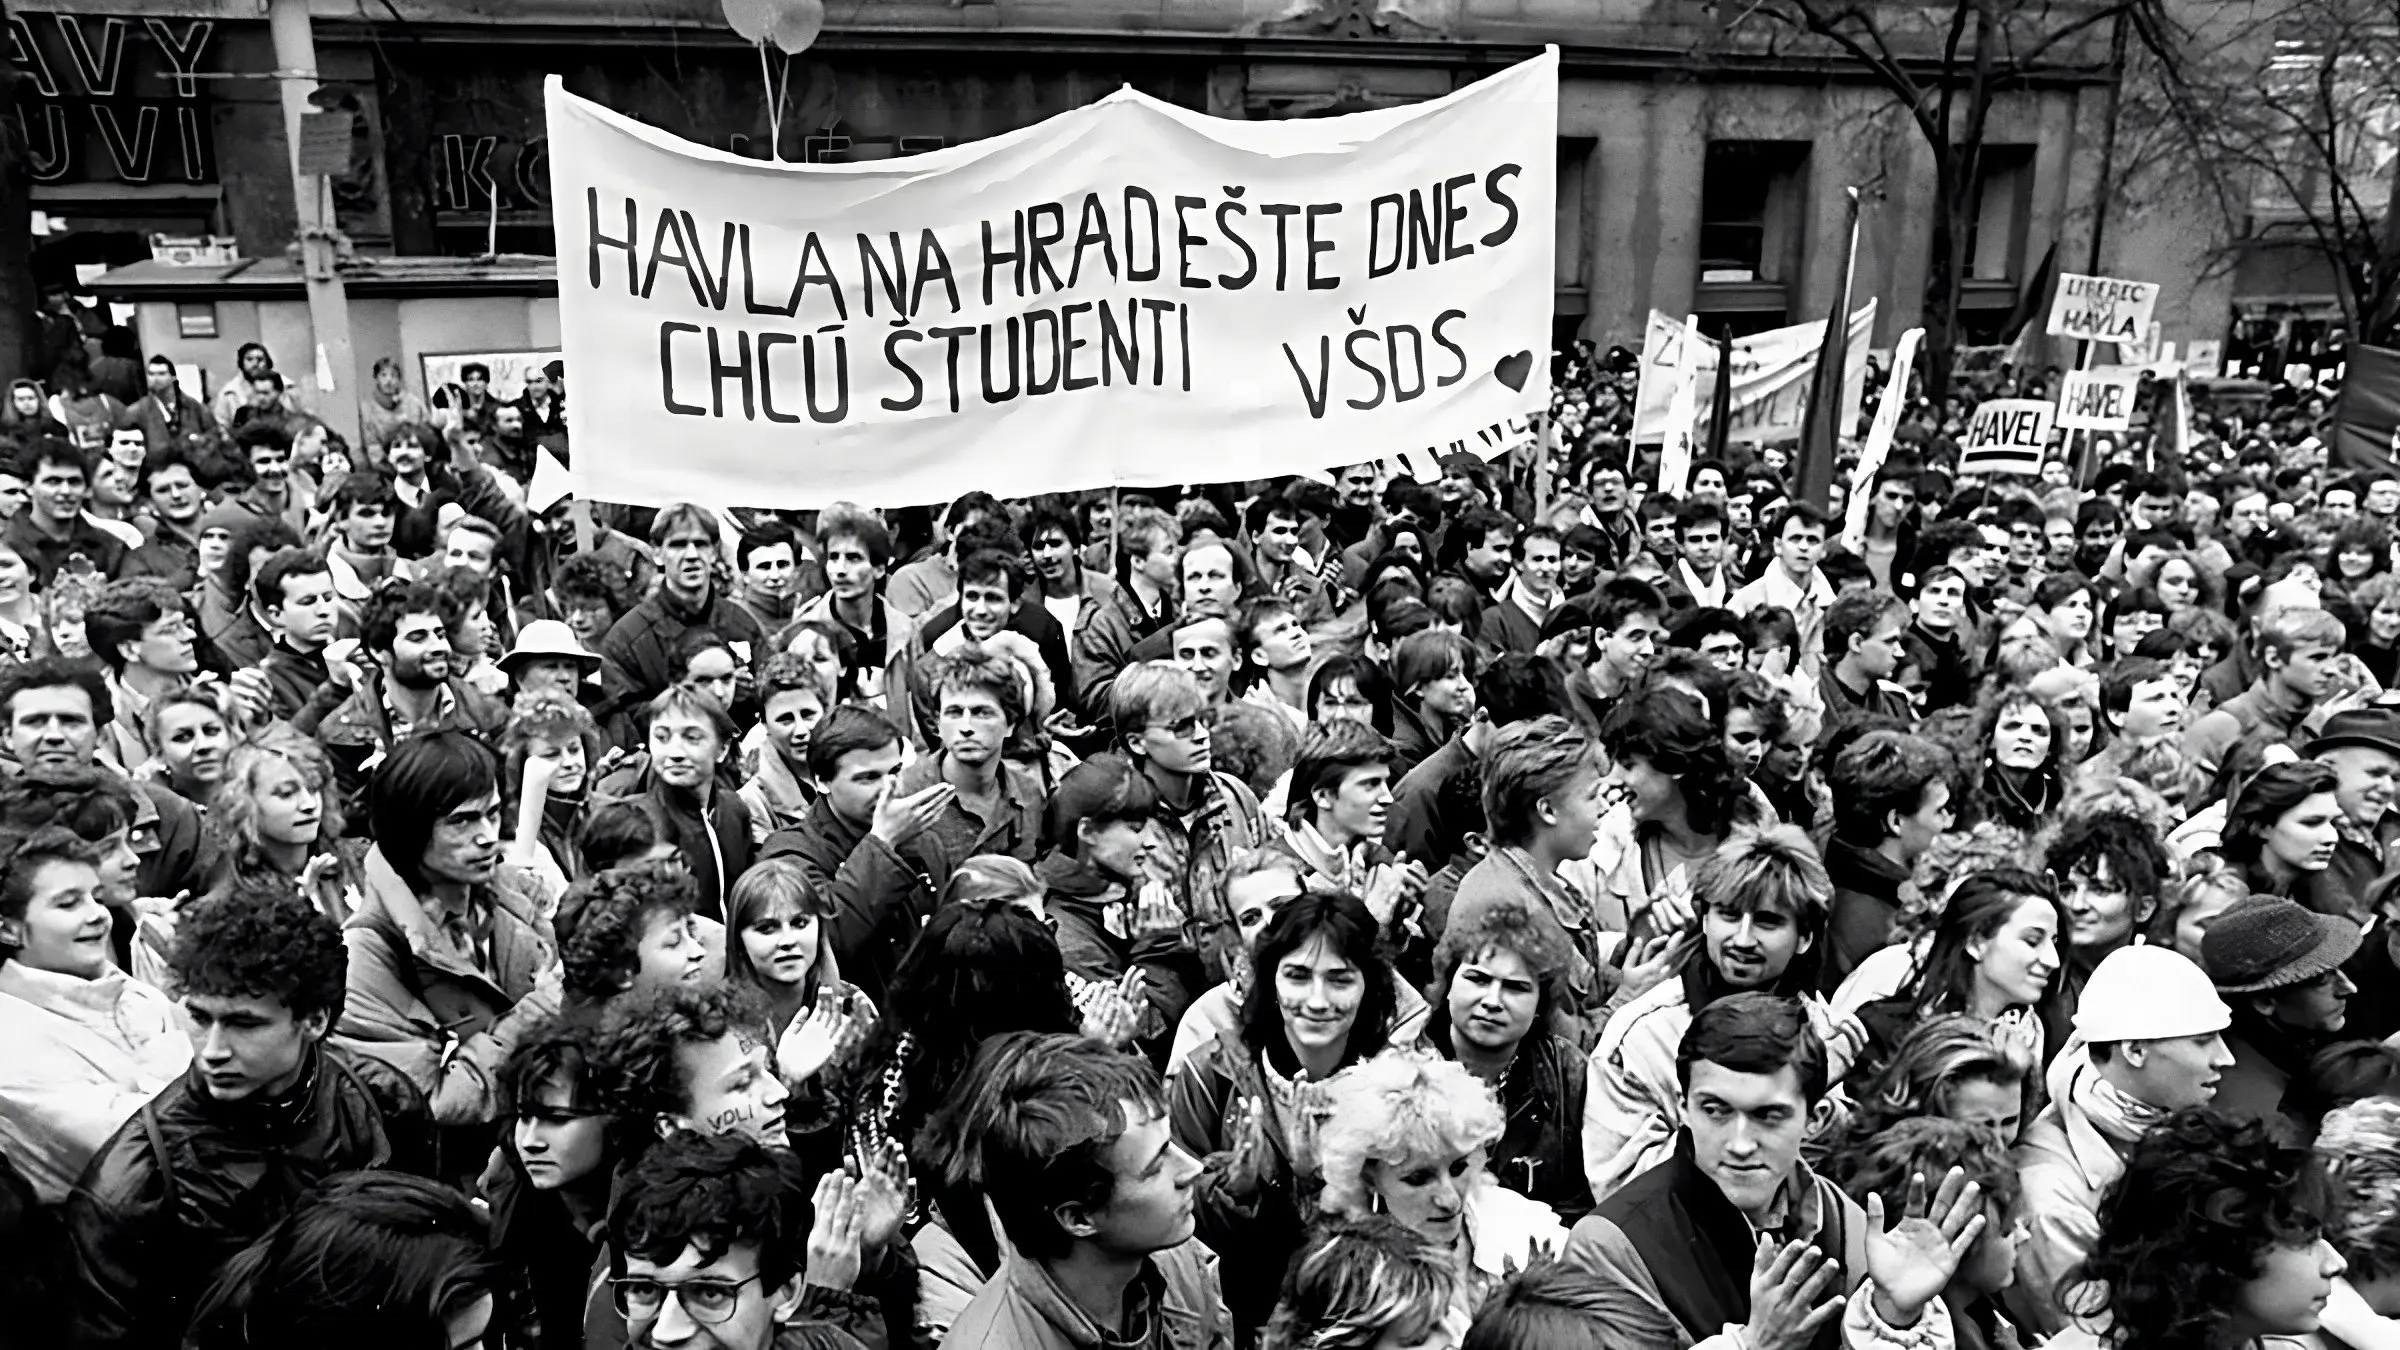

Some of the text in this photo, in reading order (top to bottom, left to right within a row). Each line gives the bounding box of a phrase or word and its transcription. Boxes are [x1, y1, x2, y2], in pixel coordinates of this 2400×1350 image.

[587, 186, 848, 321] HAVLA
[857, 229, 960, 318] NA
[1369, 163, 1522, 280] DNES
[2062, 309, 2137, 339] HAVLA
[661, 321, 849, 424] CHCÚ
[881, 298, 1191, 413] ŠTUDENTI
[2066, 383, 2125, 418] HAVEL
[1969, 411, 2042, 448] HAVEL
